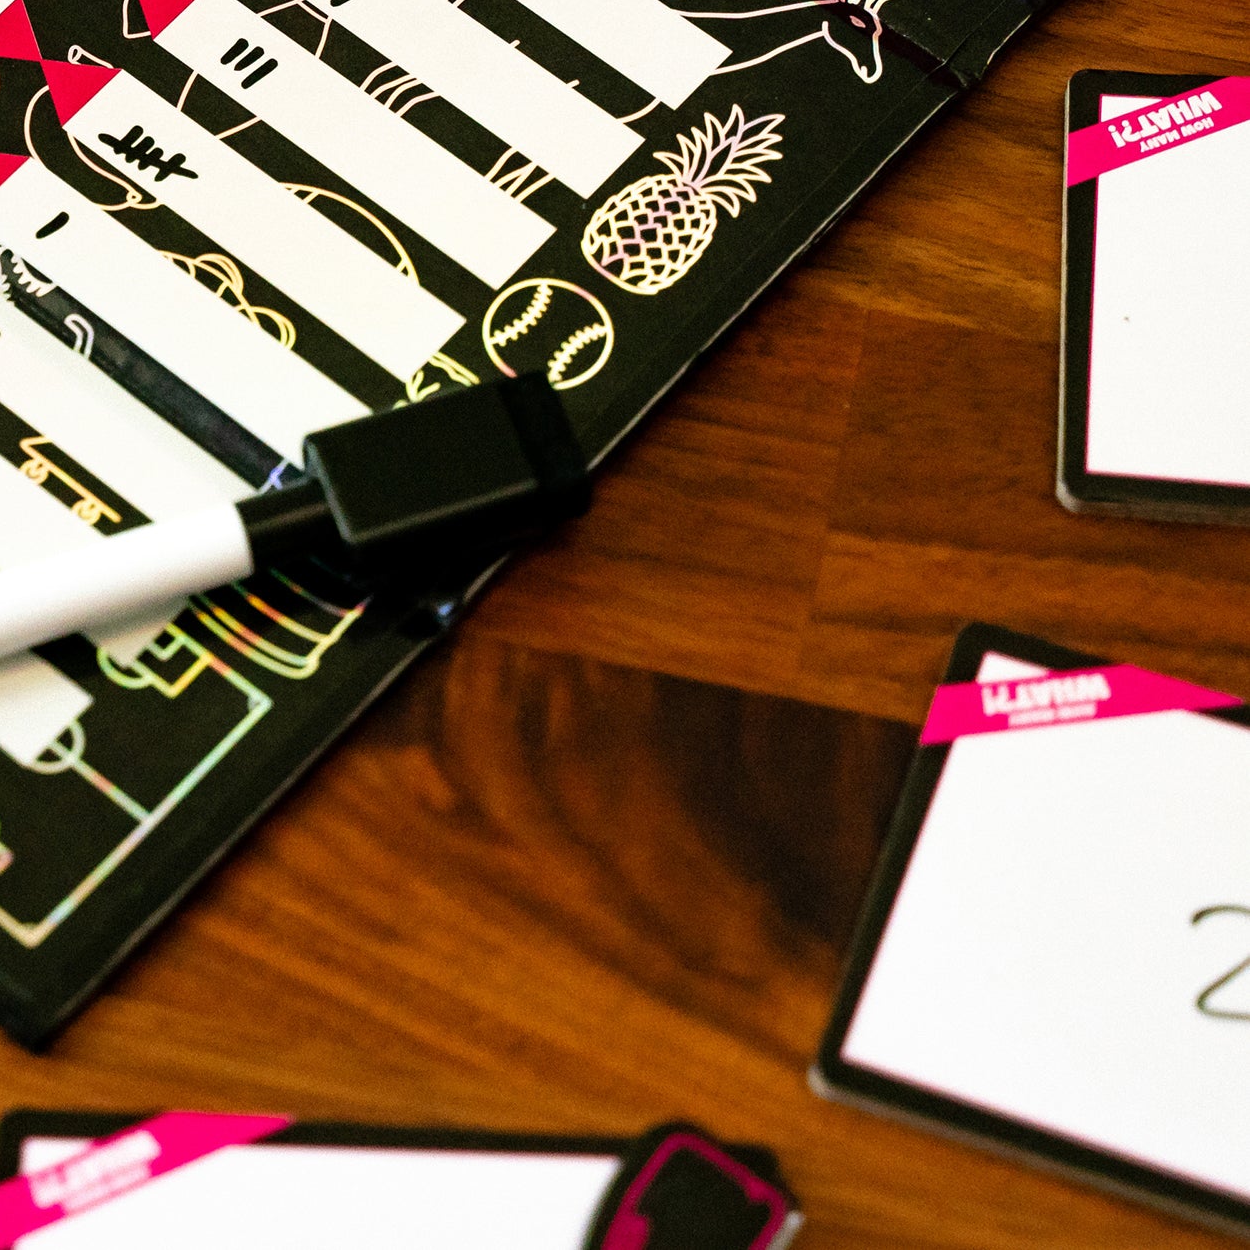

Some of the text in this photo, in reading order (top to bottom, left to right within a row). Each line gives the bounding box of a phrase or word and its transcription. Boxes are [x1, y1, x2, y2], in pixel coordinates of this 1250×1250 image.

[1107, 90, 1223, 148] WHAT?!
[1139, 116, 1215, 153] HOW MANY
